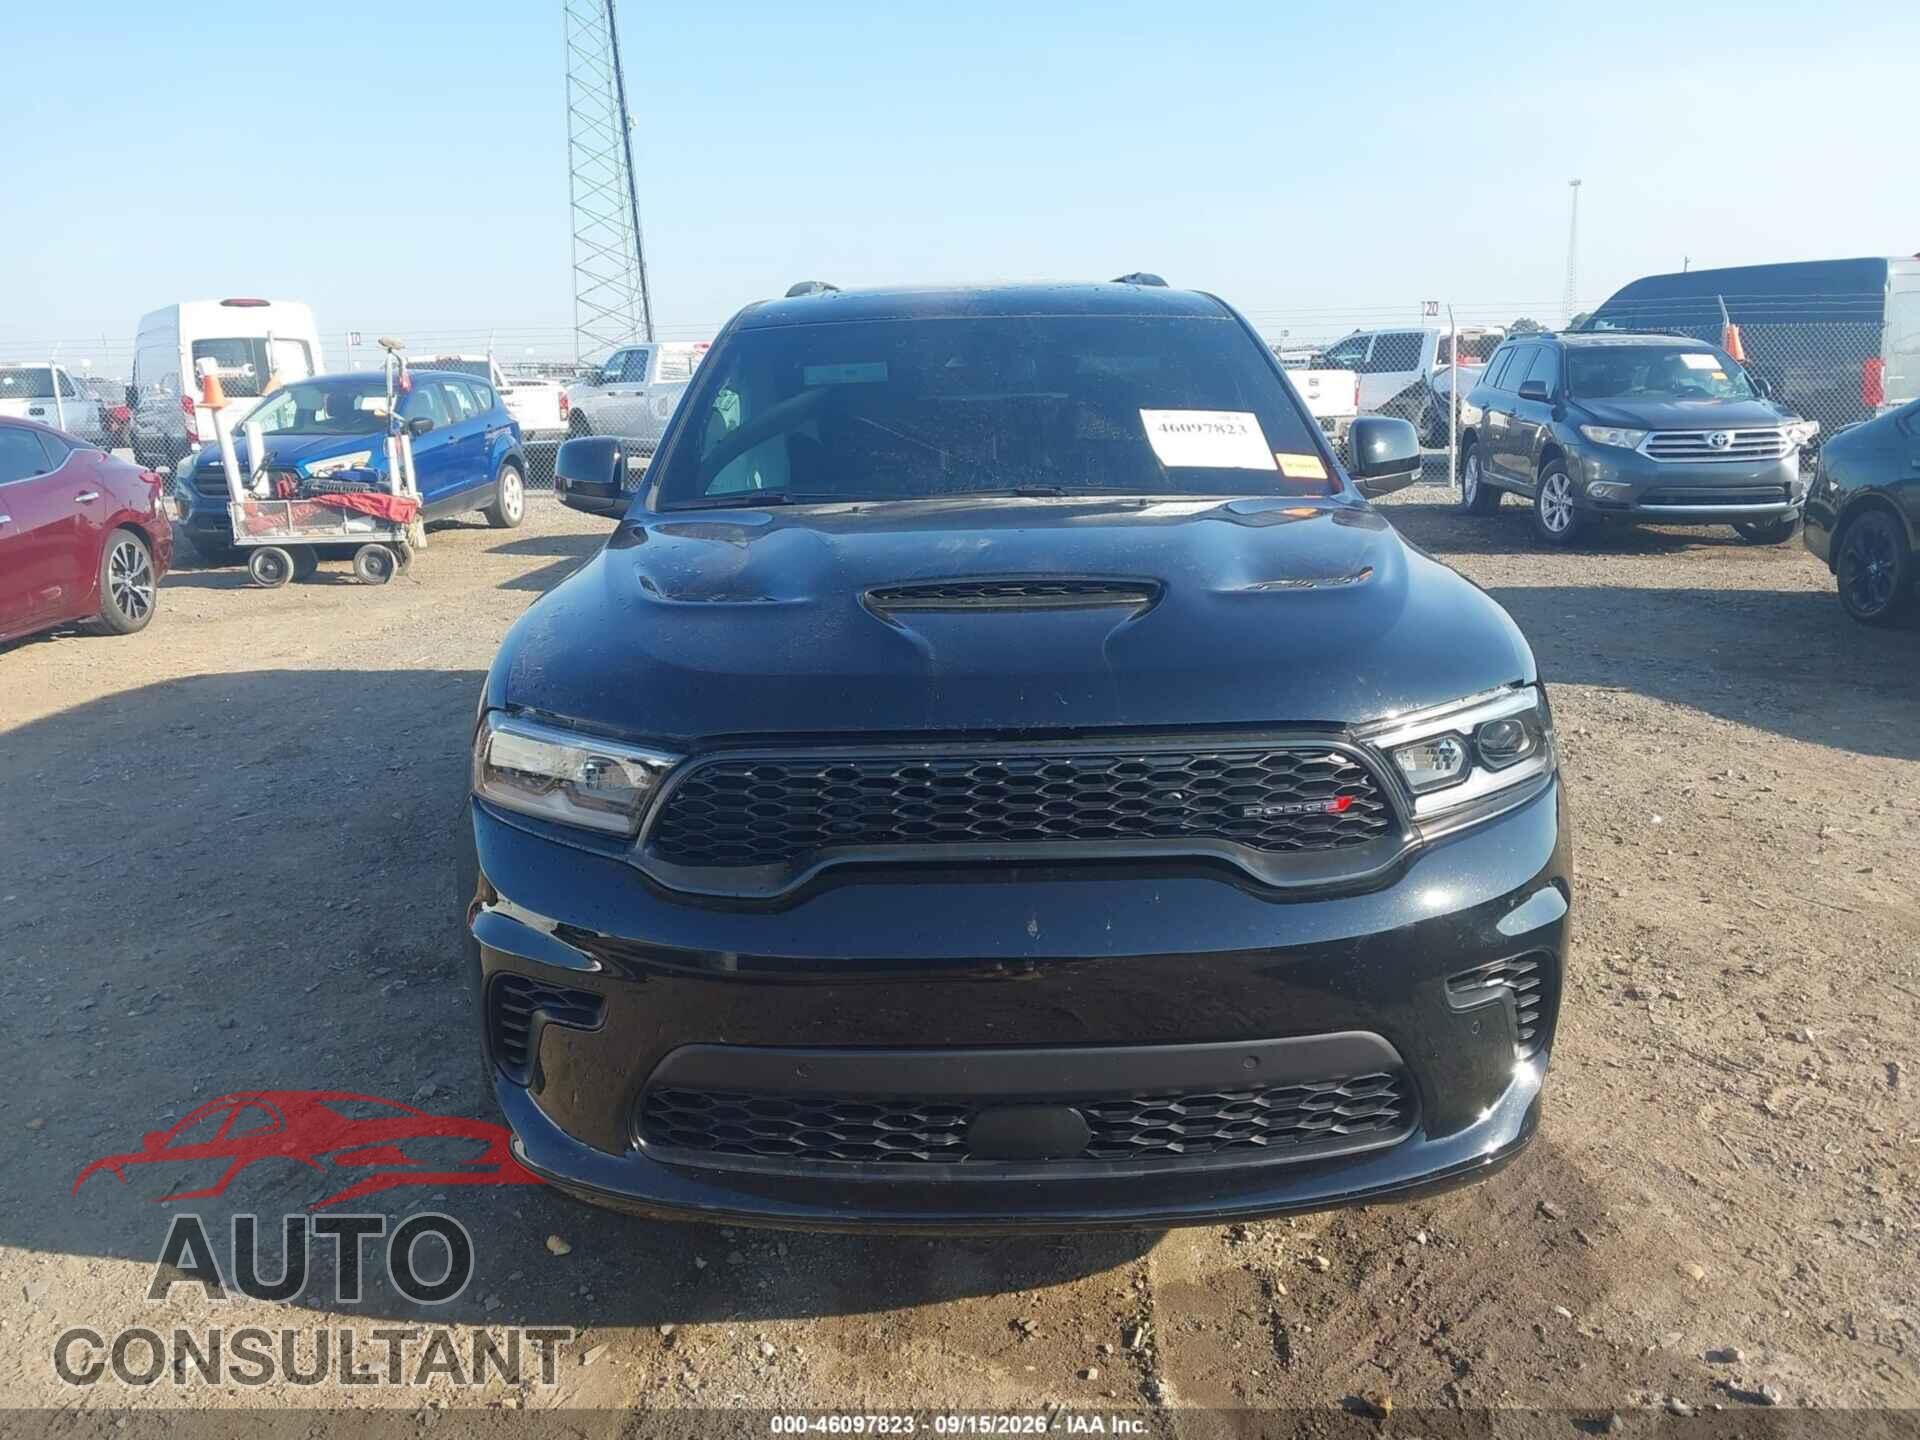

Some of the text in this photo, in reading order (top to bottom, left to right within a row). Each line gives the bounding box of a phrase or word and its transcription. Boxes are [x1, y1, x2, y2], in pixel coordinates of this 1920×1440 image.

[1425, 301, 1439, 316] 20
[1158, 423, 1248, 434] 46097823
[1243, 801, 1338, 817] DODGE
